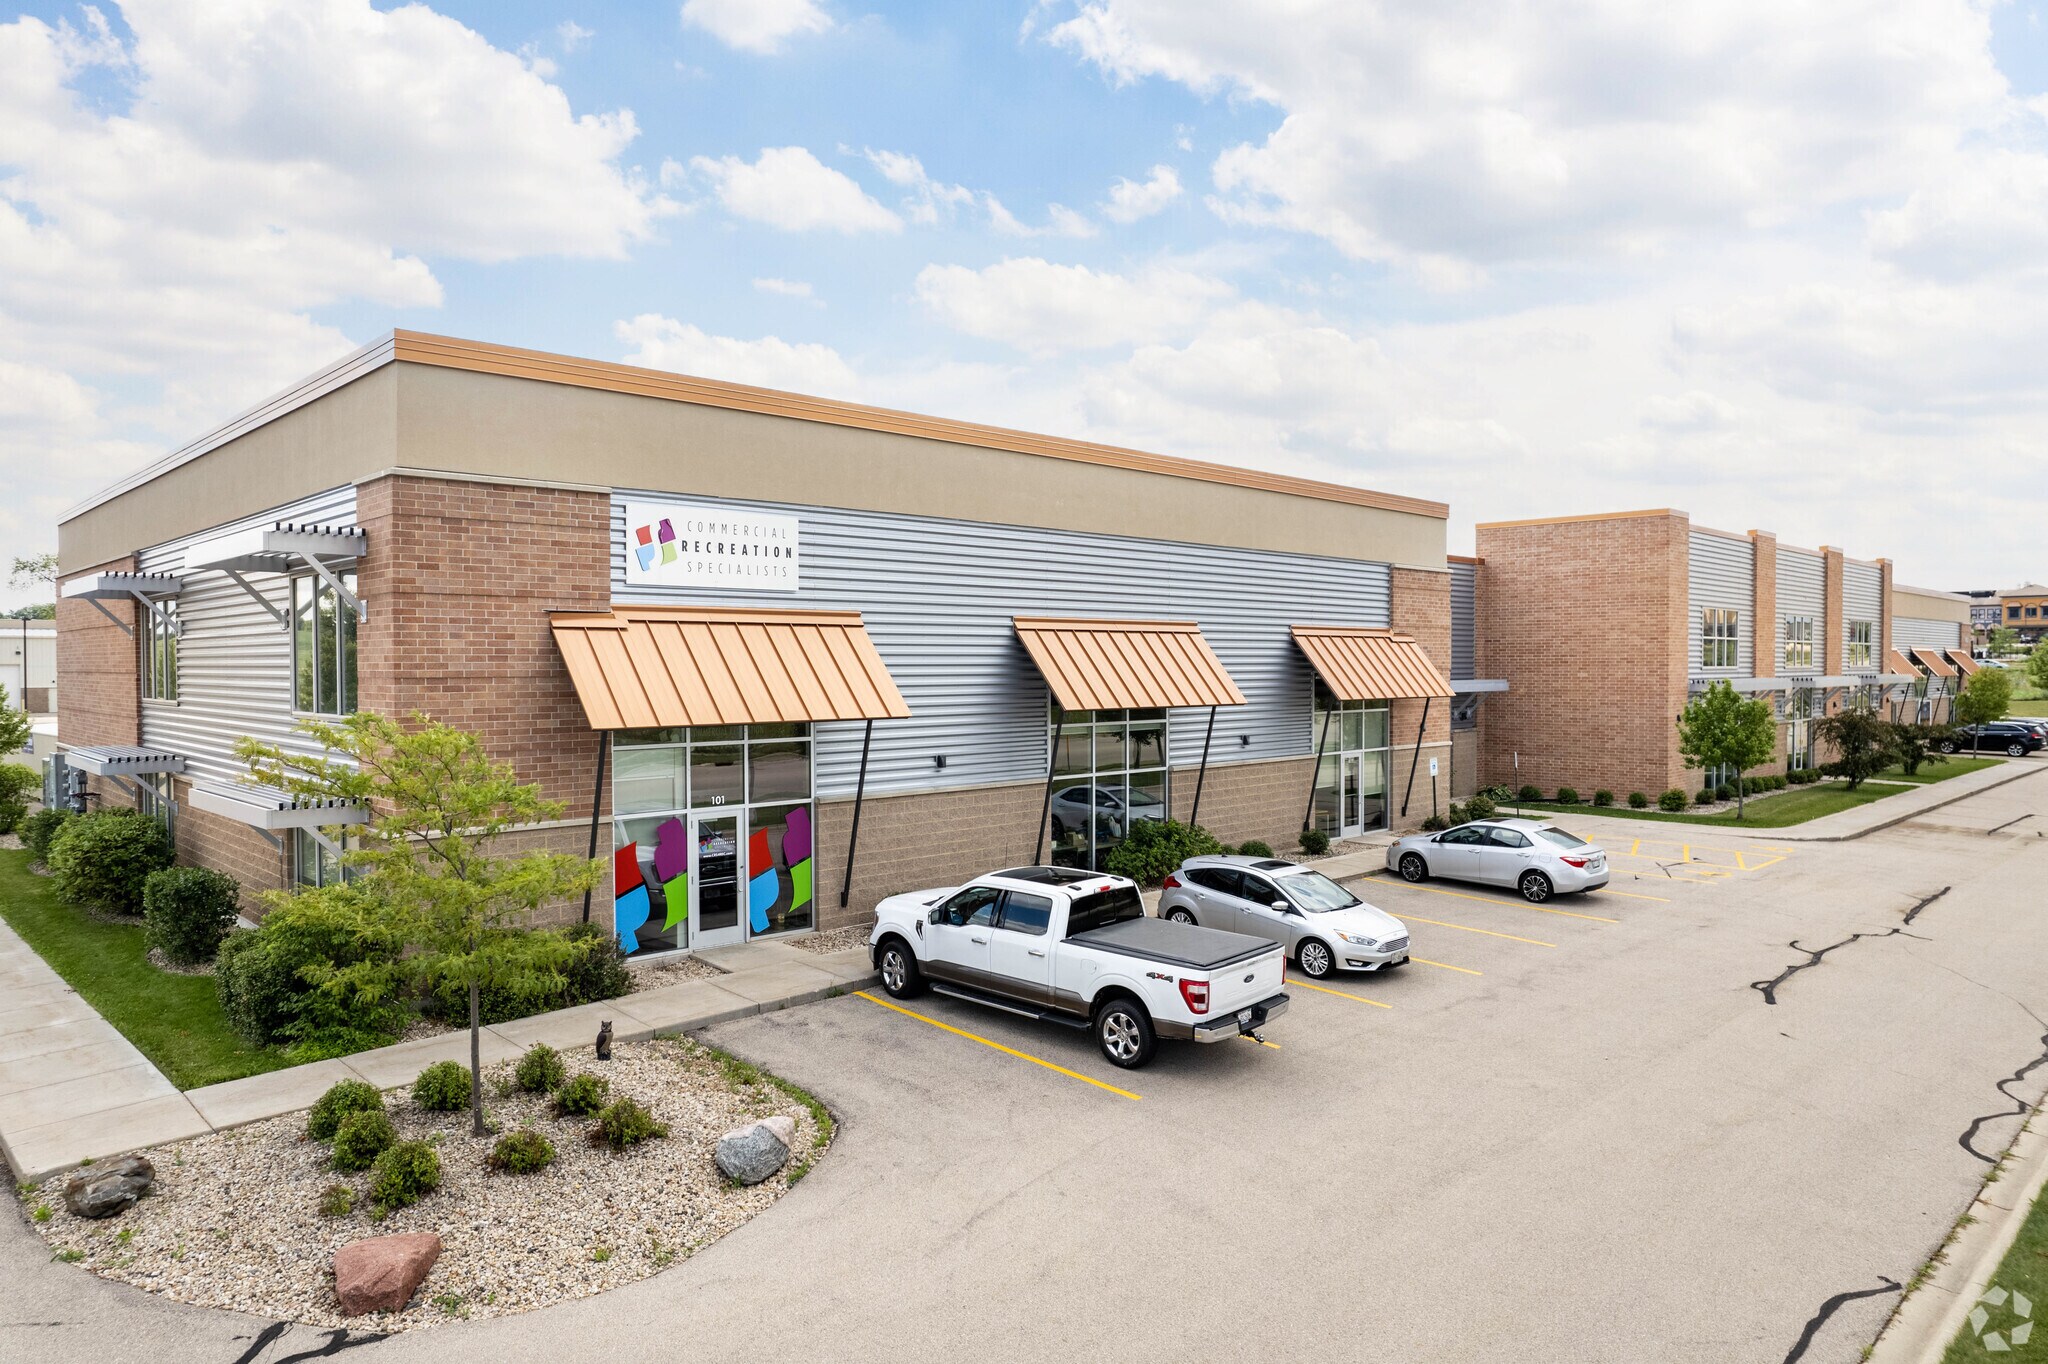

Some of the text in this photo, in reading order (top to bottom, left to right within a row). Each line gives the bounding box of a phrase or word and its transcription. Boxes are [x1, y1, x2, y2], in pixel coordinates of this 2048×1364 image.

[687, 520, 786, 539] COMMERCIAL
[681, 540, 792, 558] RECREATION
[687, 561, 787, 577] SPECIALISTS
[711, 796, 725, 805] 101
